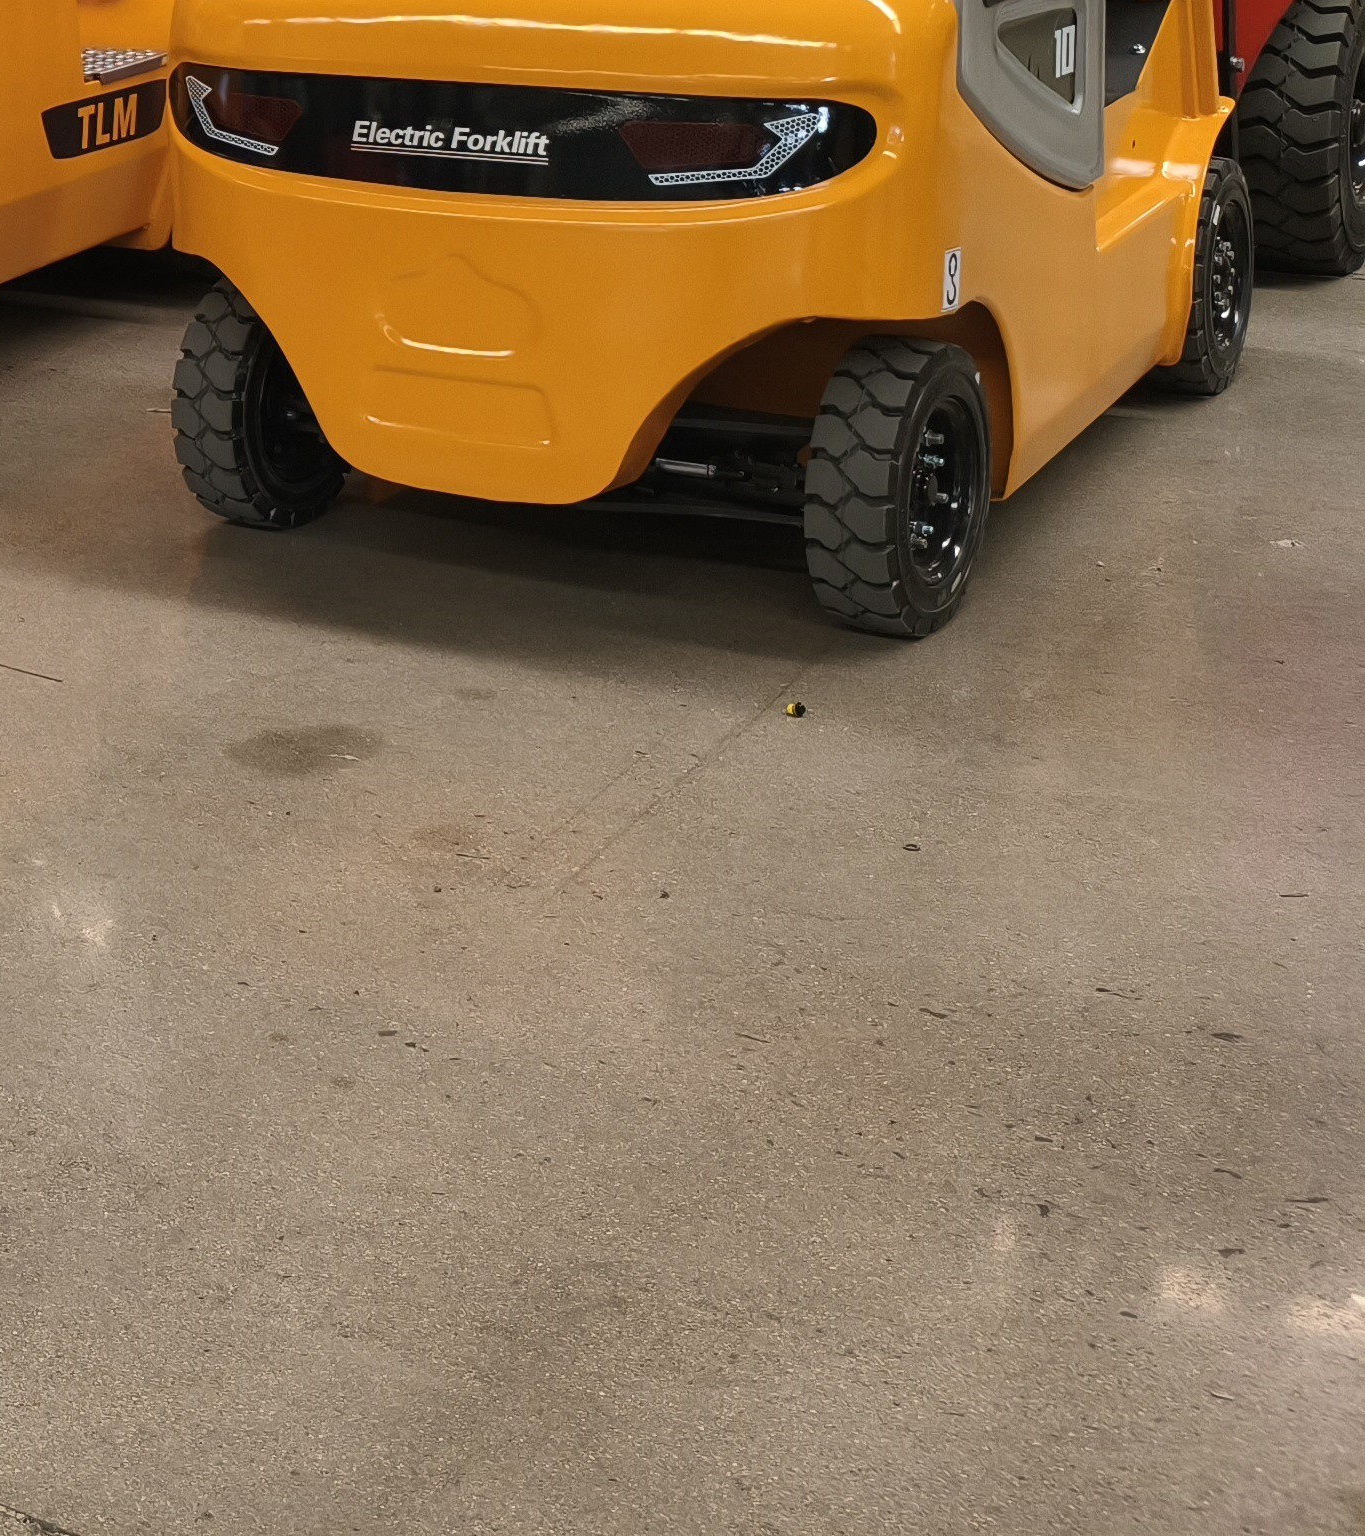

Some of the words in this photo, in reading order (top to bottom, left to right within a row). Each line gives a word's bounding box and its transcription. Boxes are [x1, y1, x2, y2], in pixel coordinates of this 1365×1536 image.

[1054, 24, 1076, 78] 10
[77, 93, 138, 150] TLM
[351, 119, 445, 148] Electric
[450, 126, 550, 156] Forklift
